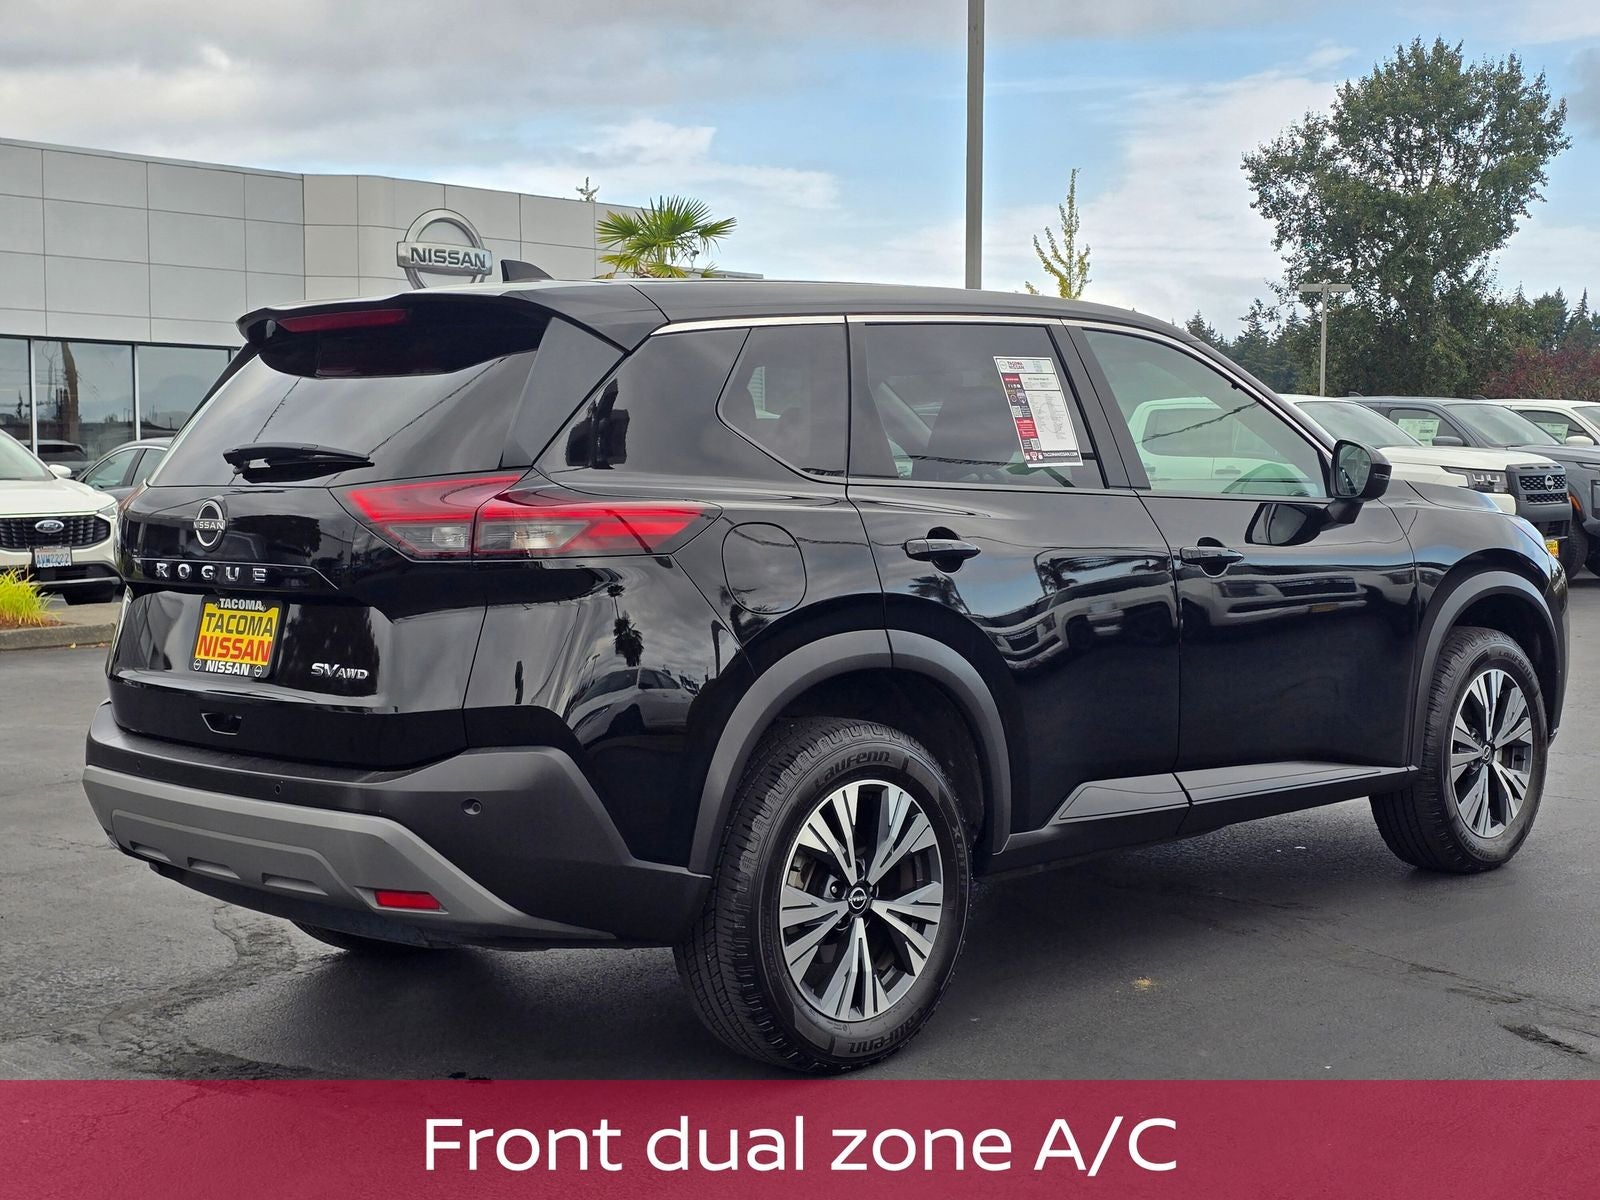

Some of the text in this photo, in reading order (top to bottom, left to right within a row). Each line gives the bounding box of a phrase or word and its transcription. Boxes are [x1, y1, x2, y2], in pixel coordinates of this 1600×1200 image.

[410, 247, 486, 269] NISSAN
[194, 519, 225, 530] NISSAN
[156, 562, 269, 583] ROGUE
[219, 598, 264, 611] TACOMA
[206, 613, 274, 638] TACOMA
[197, 635, 272, 661] NISSAN
[205, 660, 250, 676] NISSAN
[311, 662, 370, 680] SV AWD
